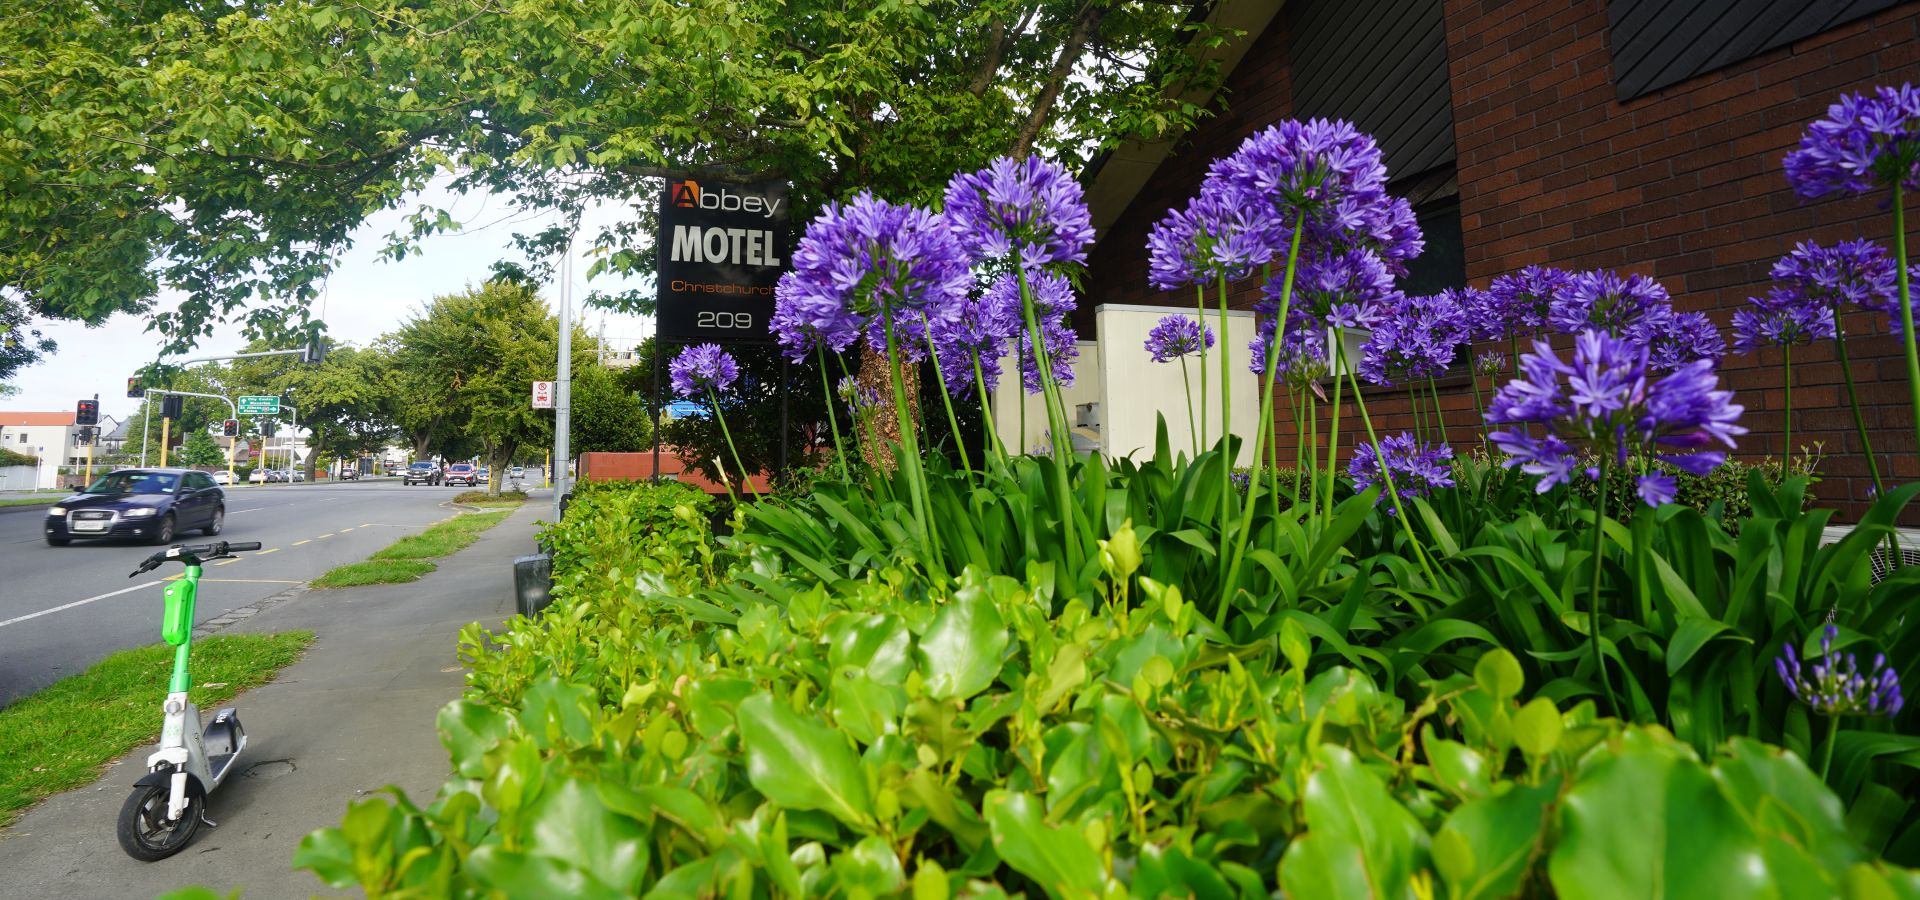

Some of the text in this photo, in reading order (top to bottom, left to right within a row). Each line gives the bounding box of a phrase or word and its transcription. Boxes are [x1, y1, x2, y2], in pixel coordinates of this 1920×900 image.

[673, 184, 781, 218] Abbey
[670, 224, 781, 267] MOTEL
[697, 311, 752, 329] 209
